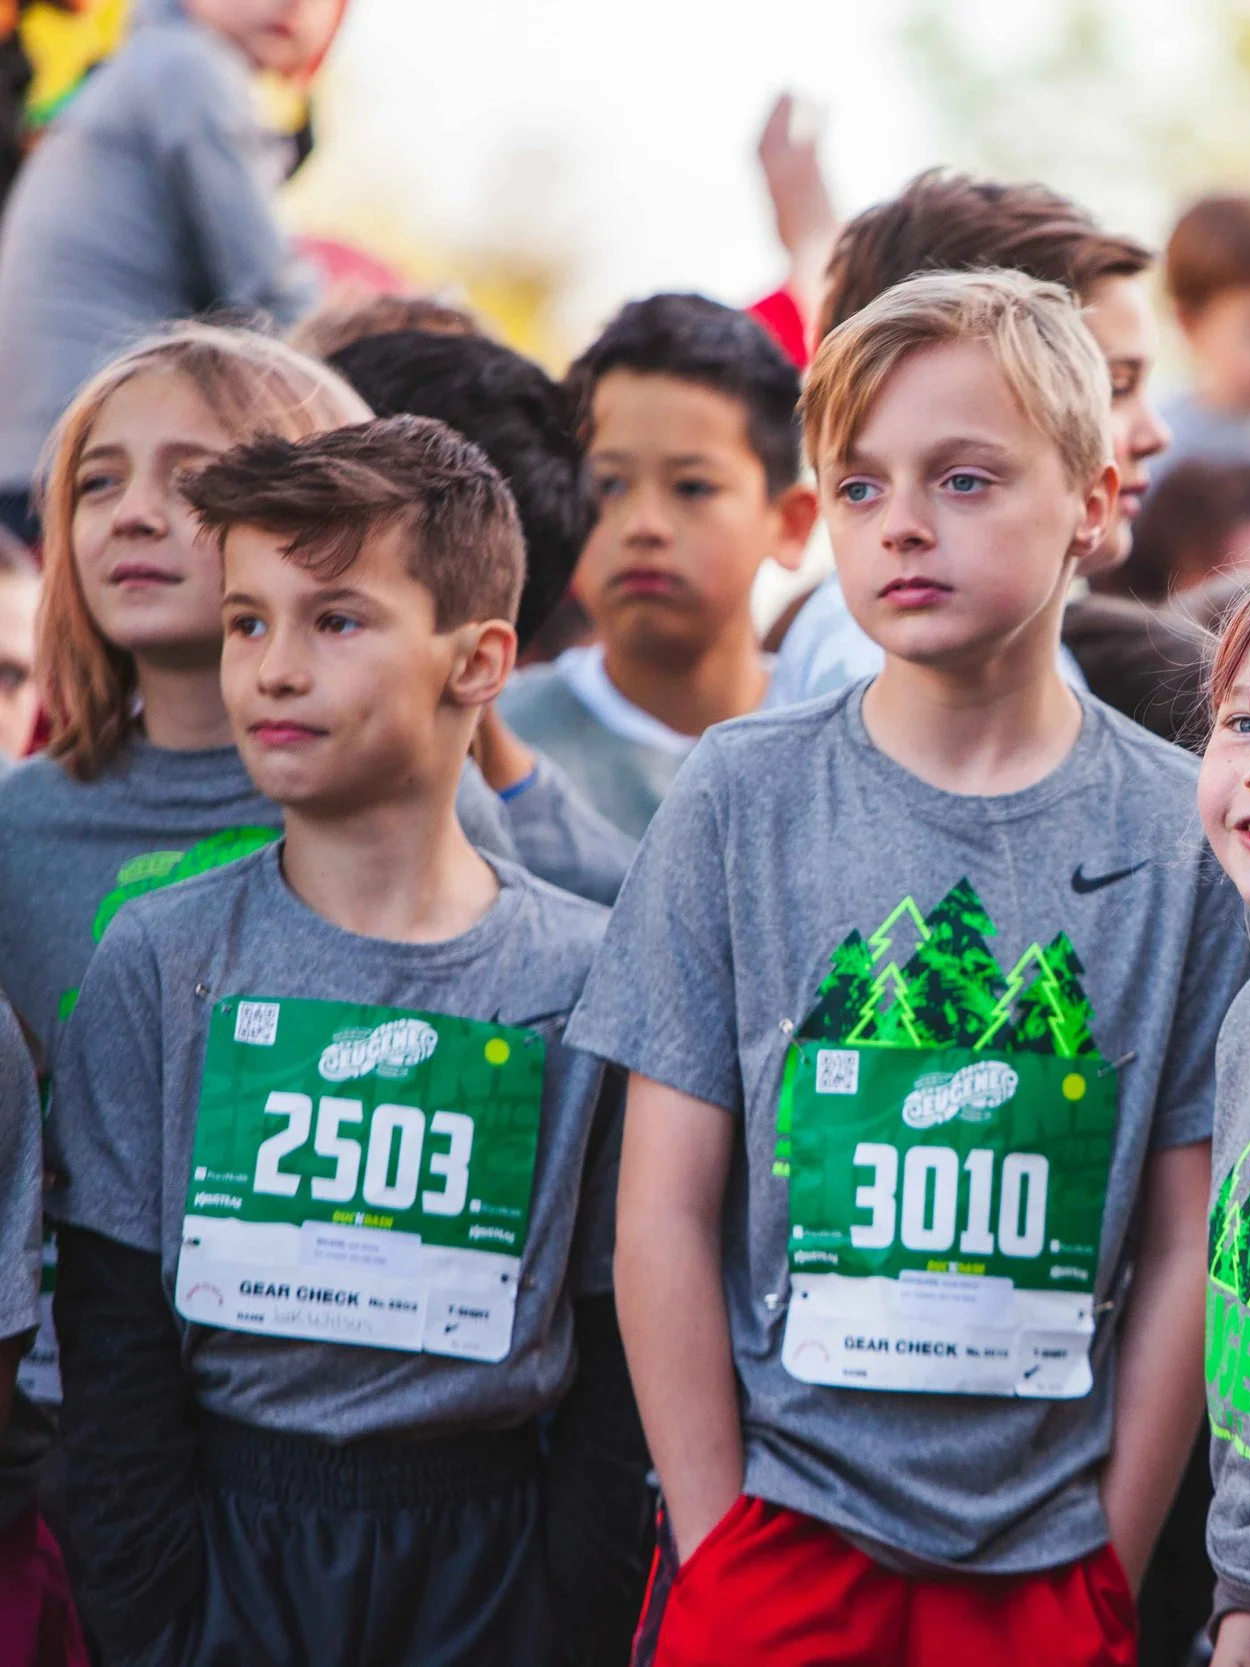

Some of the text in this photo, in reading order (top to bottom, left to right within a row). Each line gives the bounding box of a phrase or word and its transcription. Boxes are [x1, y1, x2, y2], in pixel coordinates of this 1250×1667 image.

[254, 1091, 474, 1217] 2503
[851, 1143, 1049, 1257] 3010
[239, 1280, 290, 1299] GEAR
[296, 1284, 360, 1307] CHECK
[844, 1336, 889, 1353] GEAR
[895, 1339, 958, 1359] CHECK
